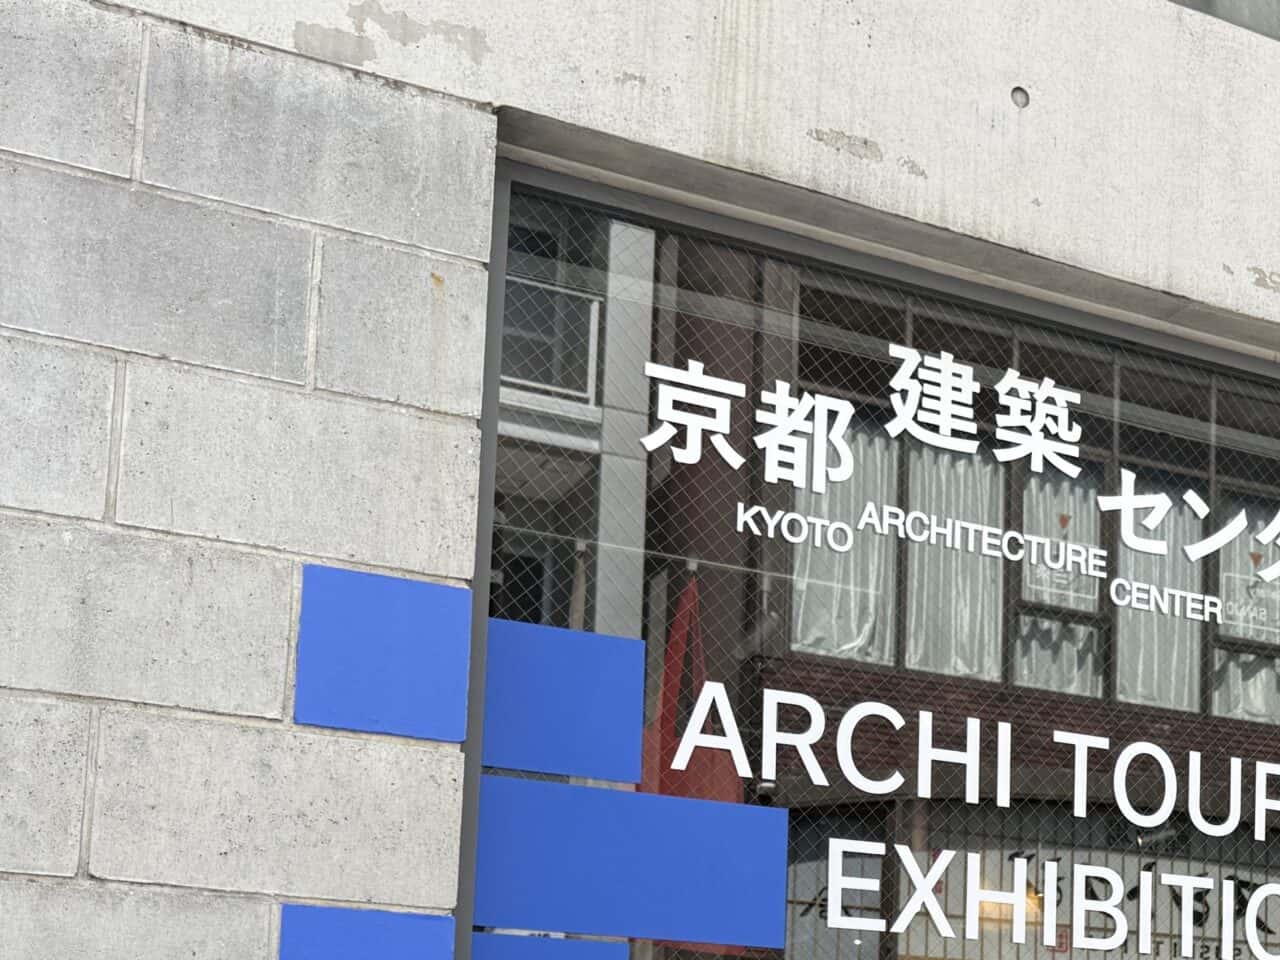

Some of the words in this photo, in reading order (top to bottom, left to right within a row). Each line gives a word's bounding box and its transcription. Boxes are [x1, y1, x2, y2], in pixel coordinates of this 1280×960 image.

[640, 359, 855, 494] 京都
[884, 343, 1082, 478] 建築
[736, 502, 854, 552] KYOTO
[857, 501, 1107, 578] ARCHITECTURE
[1110, 577, 1223, 624] CENTER
[671, 681, 1011, 808] ARCHI
